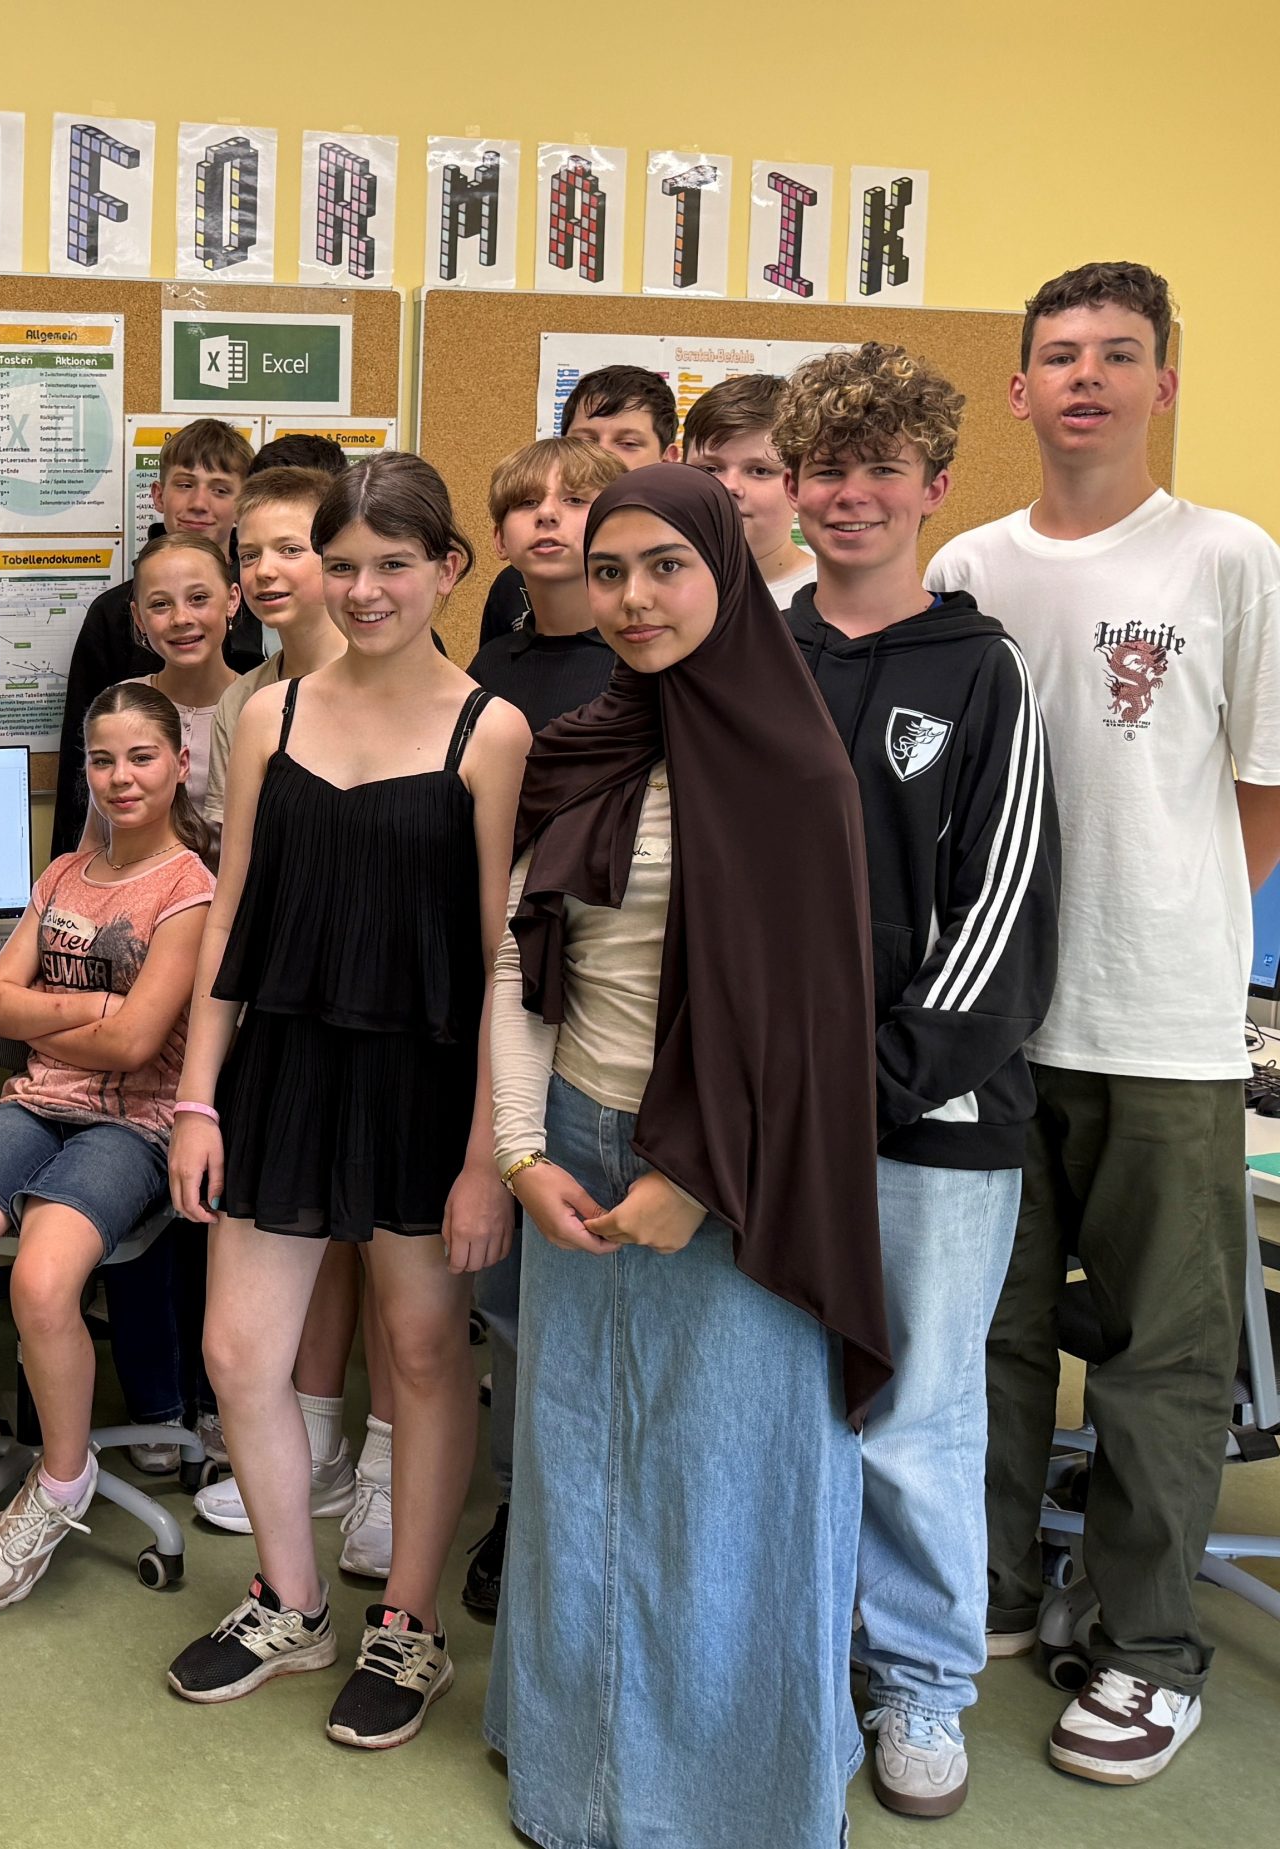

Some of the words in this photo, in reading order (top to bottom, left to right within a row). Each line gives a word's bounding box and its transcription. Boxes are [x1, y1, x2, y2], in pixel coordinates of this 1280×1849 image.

[26, 329, 78, 343] Allgemein
[55, 356, 98, 366] Aktionen
[207, 351, 220, 372] X
[262, 352, 309, 374] Excel
[675, 347, 755, 364] Scratch-Befehle
[336, 434, 376, 443] Formate
[2, 554, 101, 565] Tabellendokument
[1094, 620, 1187, 656] Infinite
